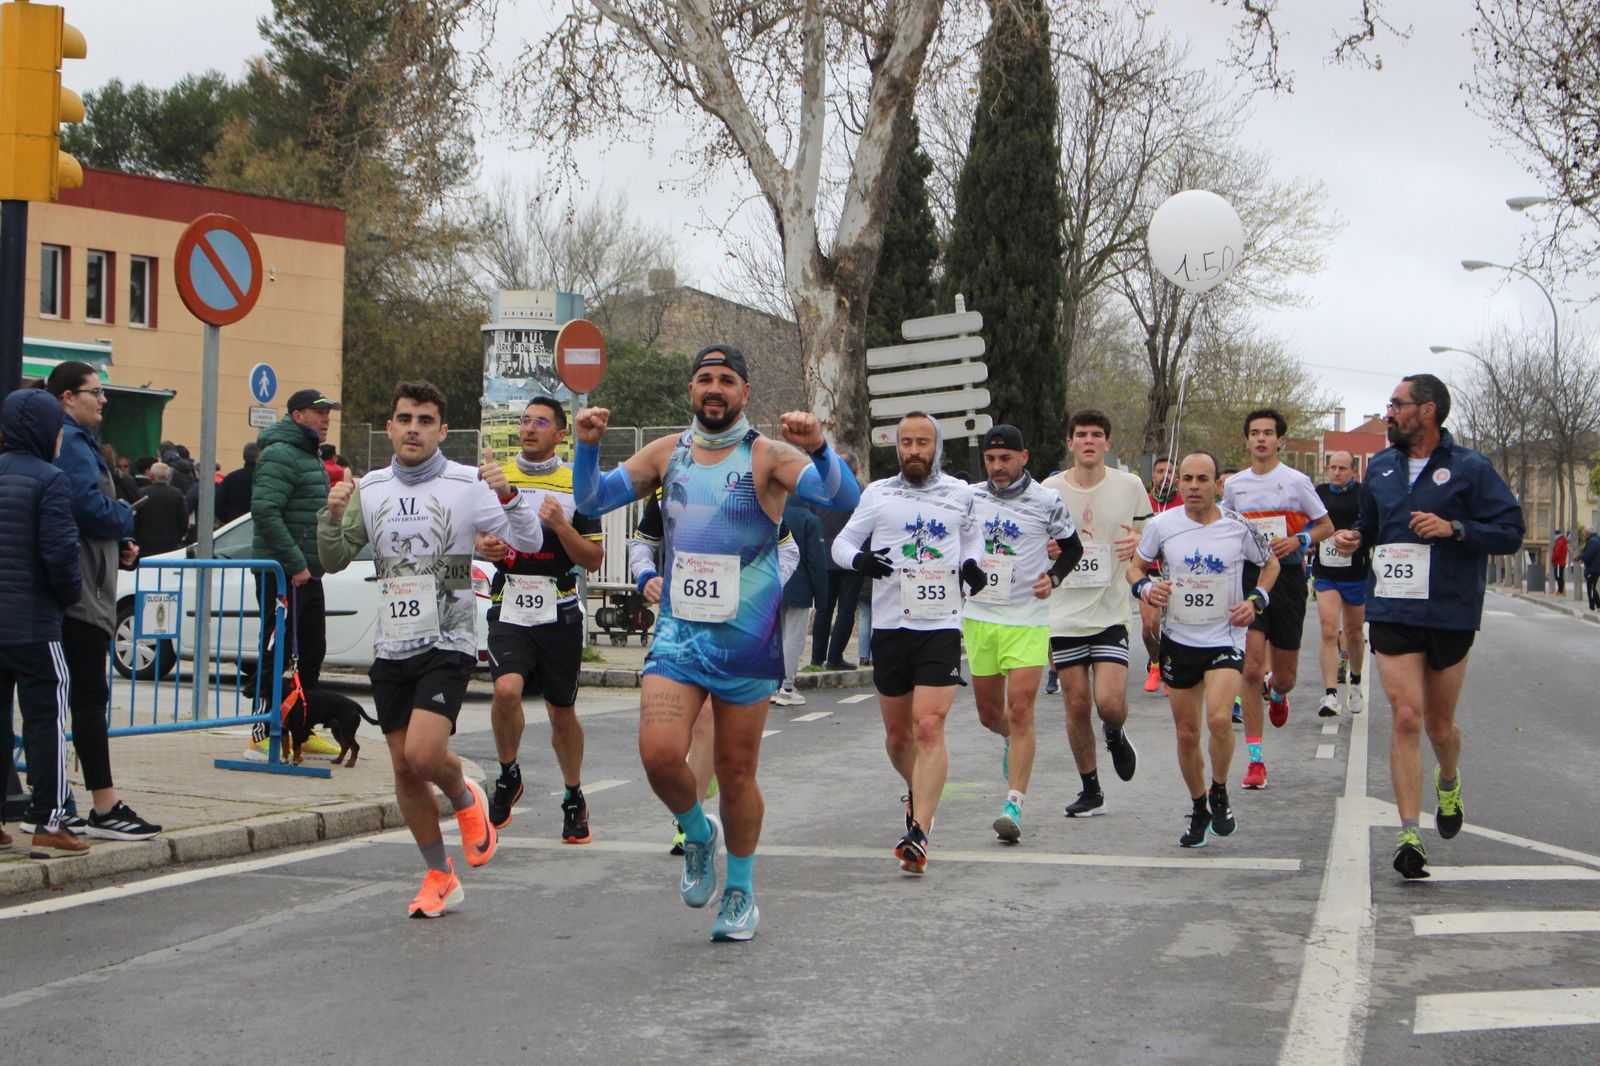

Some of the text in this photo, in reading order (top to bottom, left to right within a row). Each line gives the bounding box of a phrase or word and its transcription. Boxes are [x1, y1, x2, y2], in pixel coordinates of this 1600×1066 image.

[397, 497, 420, 516] XL
[387, 515, 429, 523] ANIVERSARIO
[1326, 547, 1338, 556] 50
[1383, 563, 1414, 579] 263
[683, 578, 720, 599] 681
[917, 585, 946, 600] 353
[515, 594, 544, 609] 439
[1184, 593, 1215, 607] 982
[389, 599, 421, 619] 128
